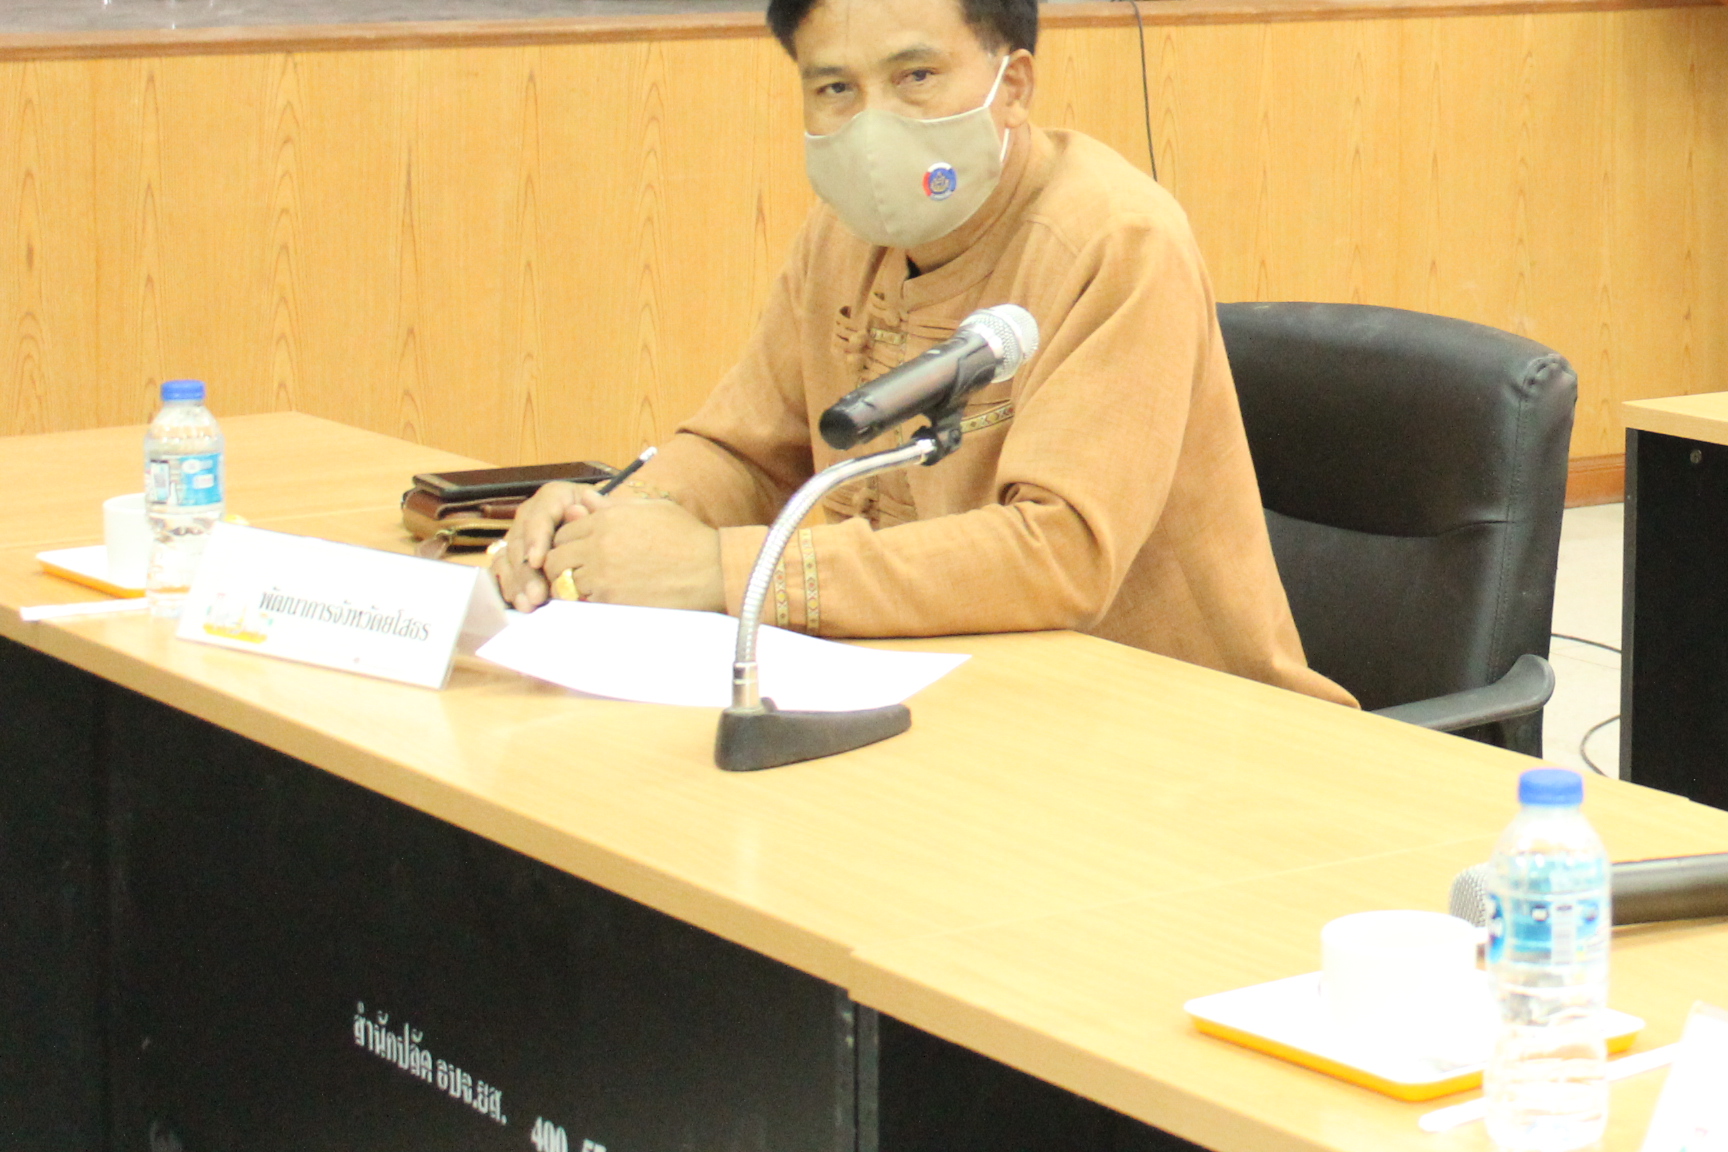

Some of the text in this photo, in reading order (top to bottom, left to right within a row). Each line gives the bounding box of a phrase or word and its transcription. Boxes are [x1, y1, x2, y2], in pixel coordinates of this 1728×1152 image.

[258, 585, 432, 642] พัฒนาการจังหวัดยโสธร
[352, 1000, 433, 1084] สำนักปลัด
[530, 1115, 569, 1152] 400
